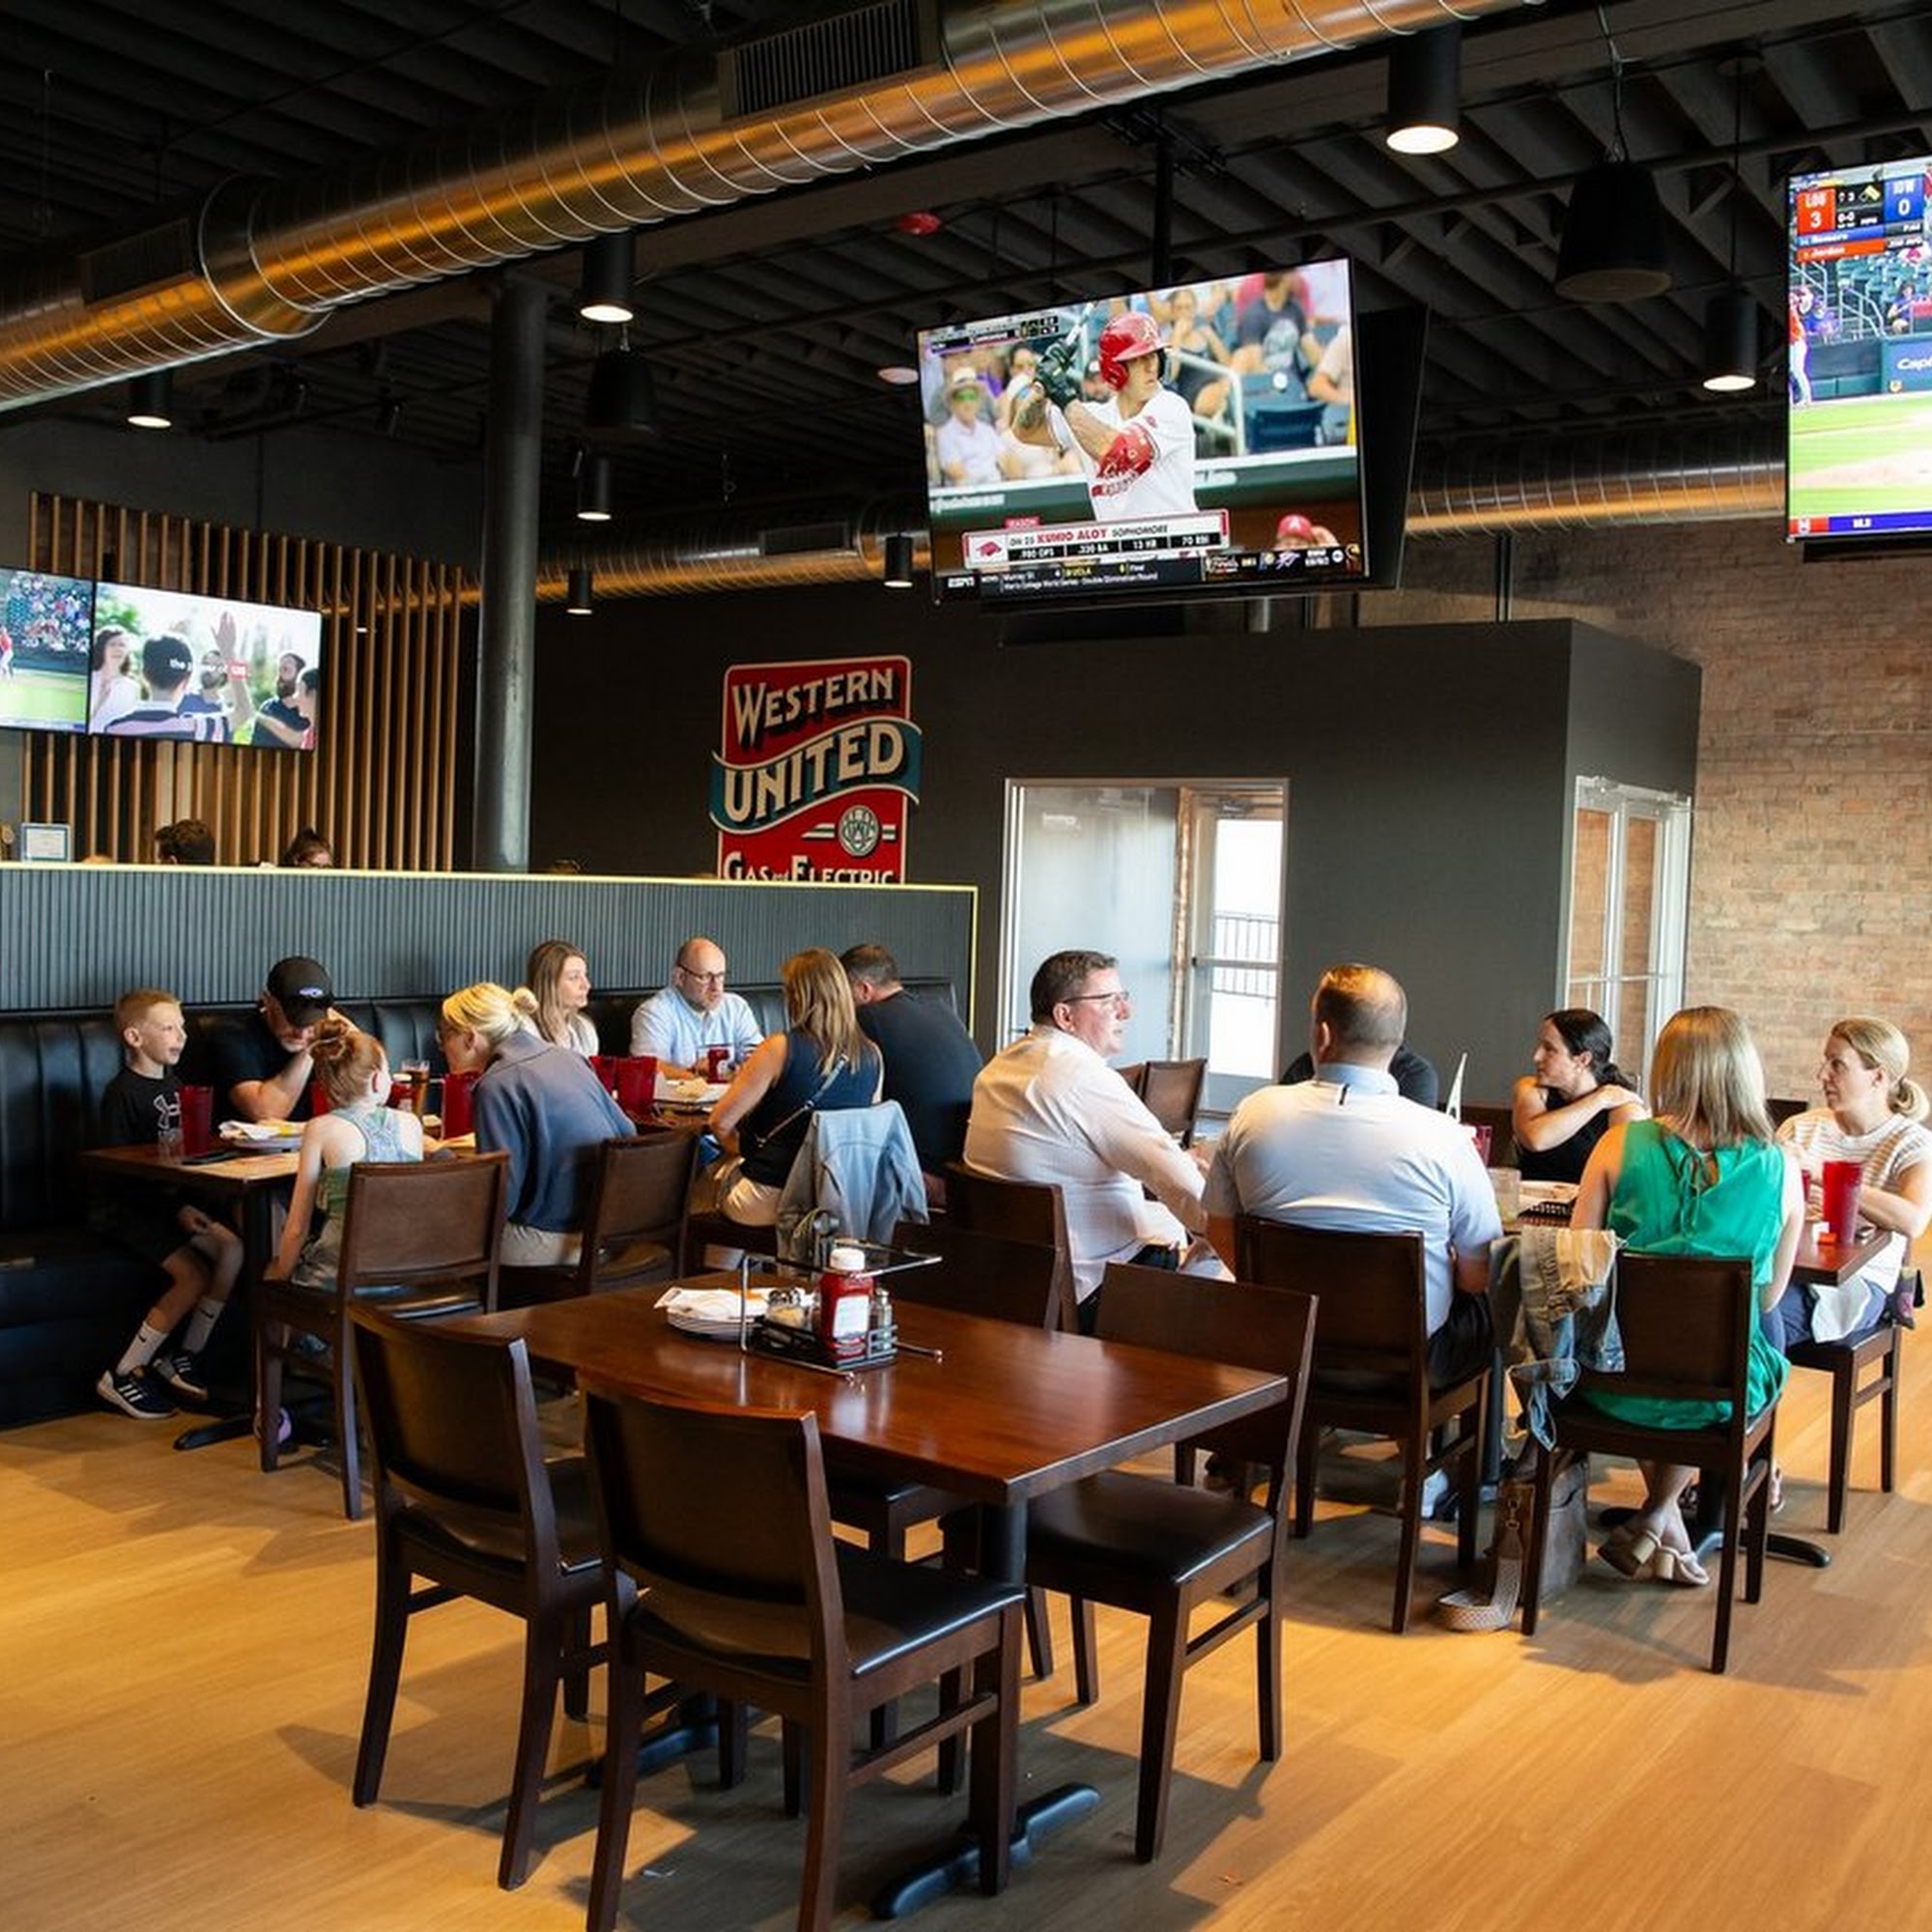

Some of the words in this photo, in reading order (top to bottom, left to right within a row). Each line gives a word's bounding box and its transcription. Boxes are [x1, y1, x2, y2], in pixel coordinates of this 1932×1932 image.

[1898, 198, 1911, 215] 0
[1809, 211, 1822, 228] 3
[1077, 528, 1107, 540] ALOY
[1112, 525, 1168, 537] SOPHOMORE
[731, 668, 895, 746] WESTERN
[724, 723, 905, 823] UNITED
